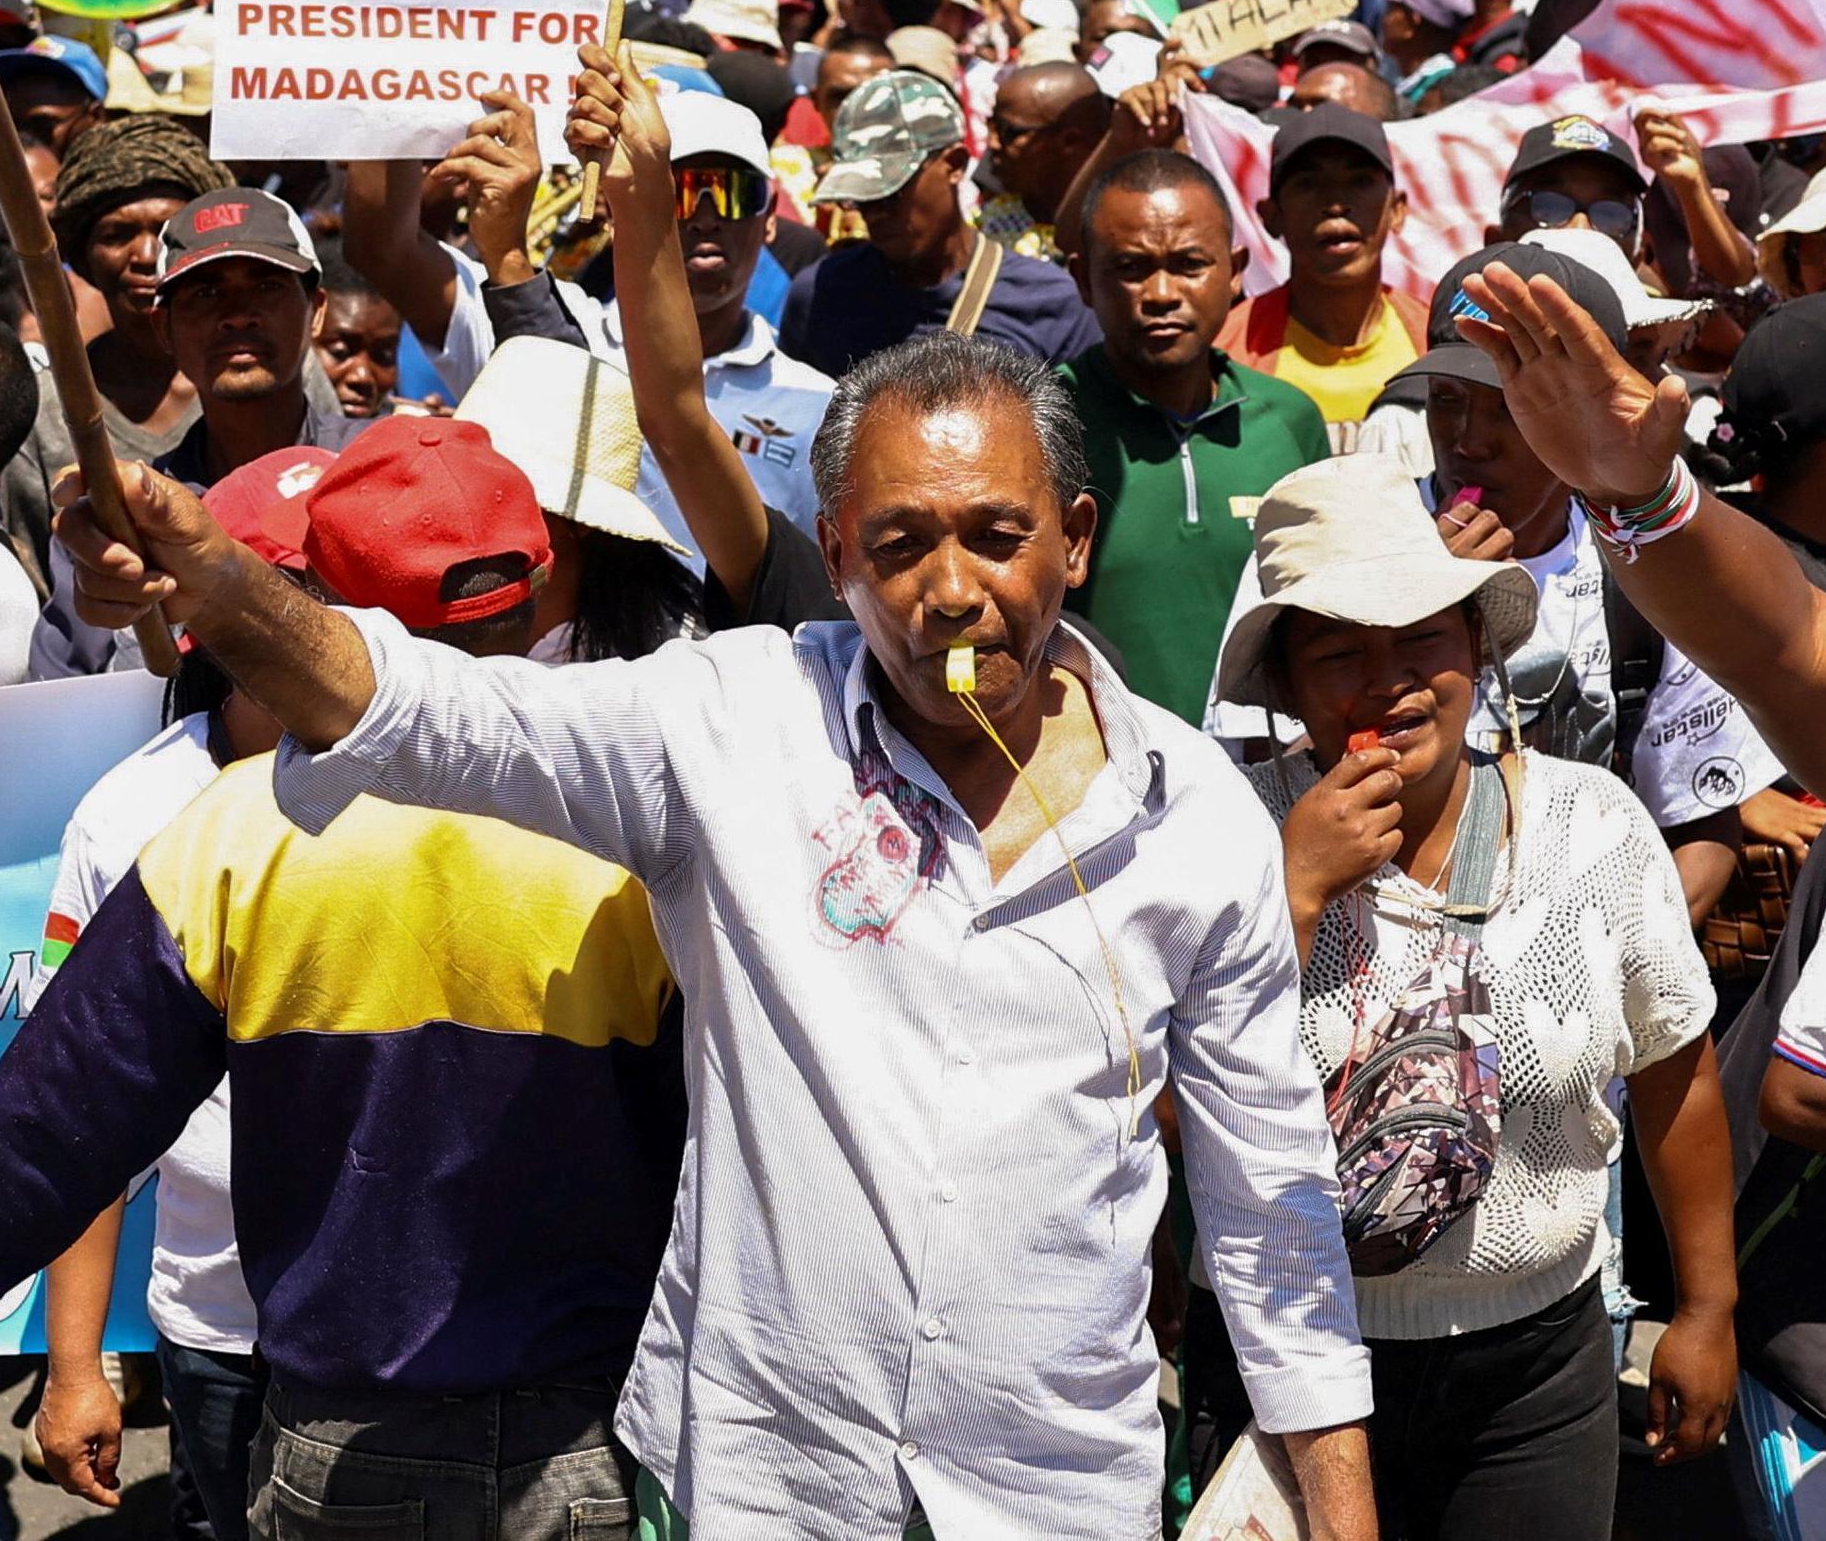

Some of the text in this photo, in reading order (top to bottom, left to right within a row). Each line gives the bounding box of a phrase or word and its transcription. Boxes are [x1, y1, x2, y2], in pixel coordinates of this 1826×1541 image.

[237, 3, 599, 45] PRESIDENT FOR
[231, 67, 550, 104] MADAGASCAR
